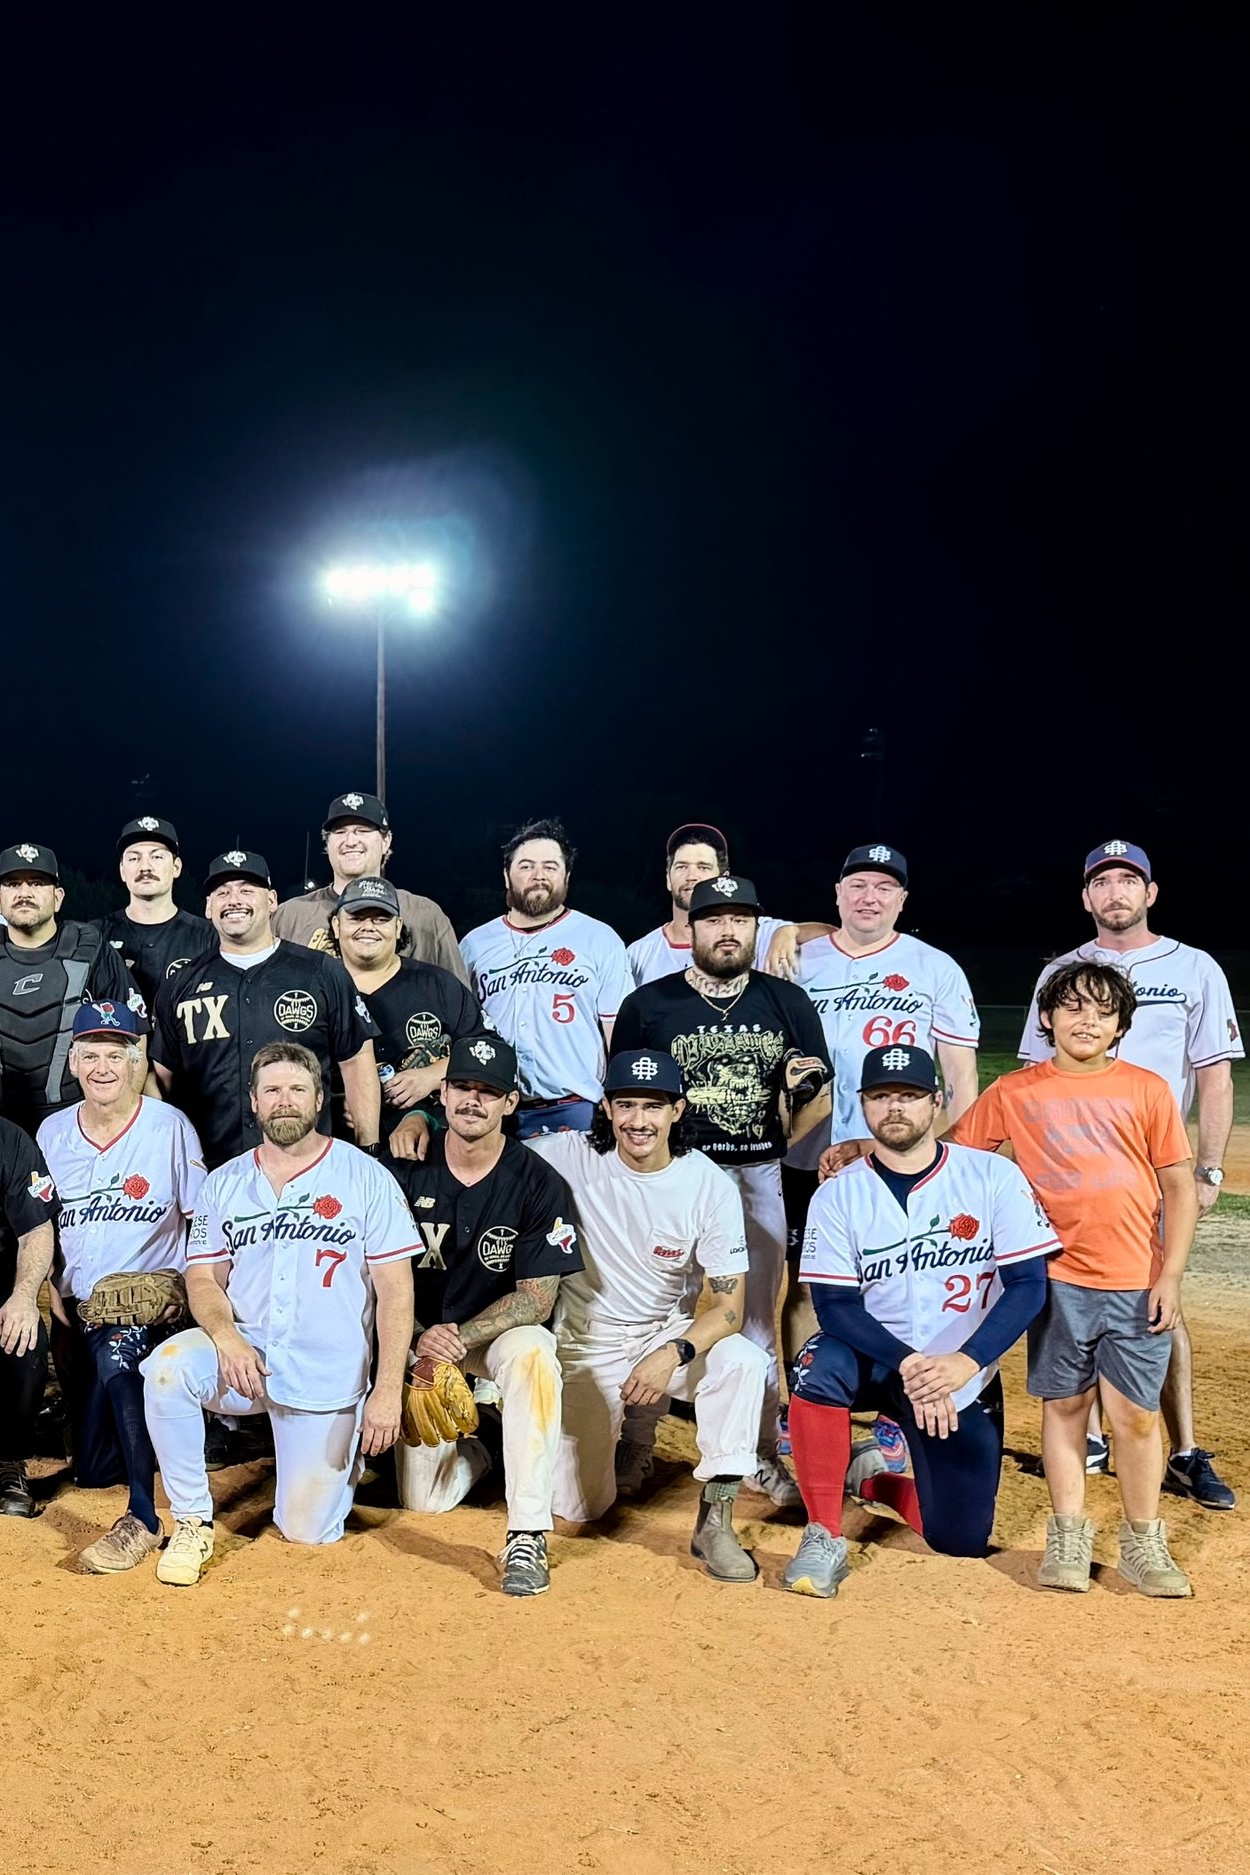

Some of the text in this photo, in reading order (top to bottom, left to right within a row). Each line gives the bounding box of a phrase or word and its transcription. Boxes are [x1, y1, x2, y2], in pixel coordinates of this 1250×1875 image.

[477, 961, 589, 1005] San Antonio
[1133, 981, 1180, 998] onio
[278, 1002, 314, 1018] DAWGS
[552, 993, 575, 1024] 5
[833, 988, 924, 1014] Antonio
[176, 994, 231, 1045] TX
[409, 1024, 440, 1040] DAWGS
[696, 1023, 762, 1034] TEXAS
[862, 1015, 917, 1048] 66
[59, 1195, 167, 1229] an Antonio
[221, 1212, 357, 1257] San Antonio
[417, 1222, 451, 1271] X
[482, 1239, 514, 1255] DAWG
[314, 1248, 357, 1288] 7
[856, 1237, 995, 1283] San Antonio
[941, 1272, 997, 1313] 27
